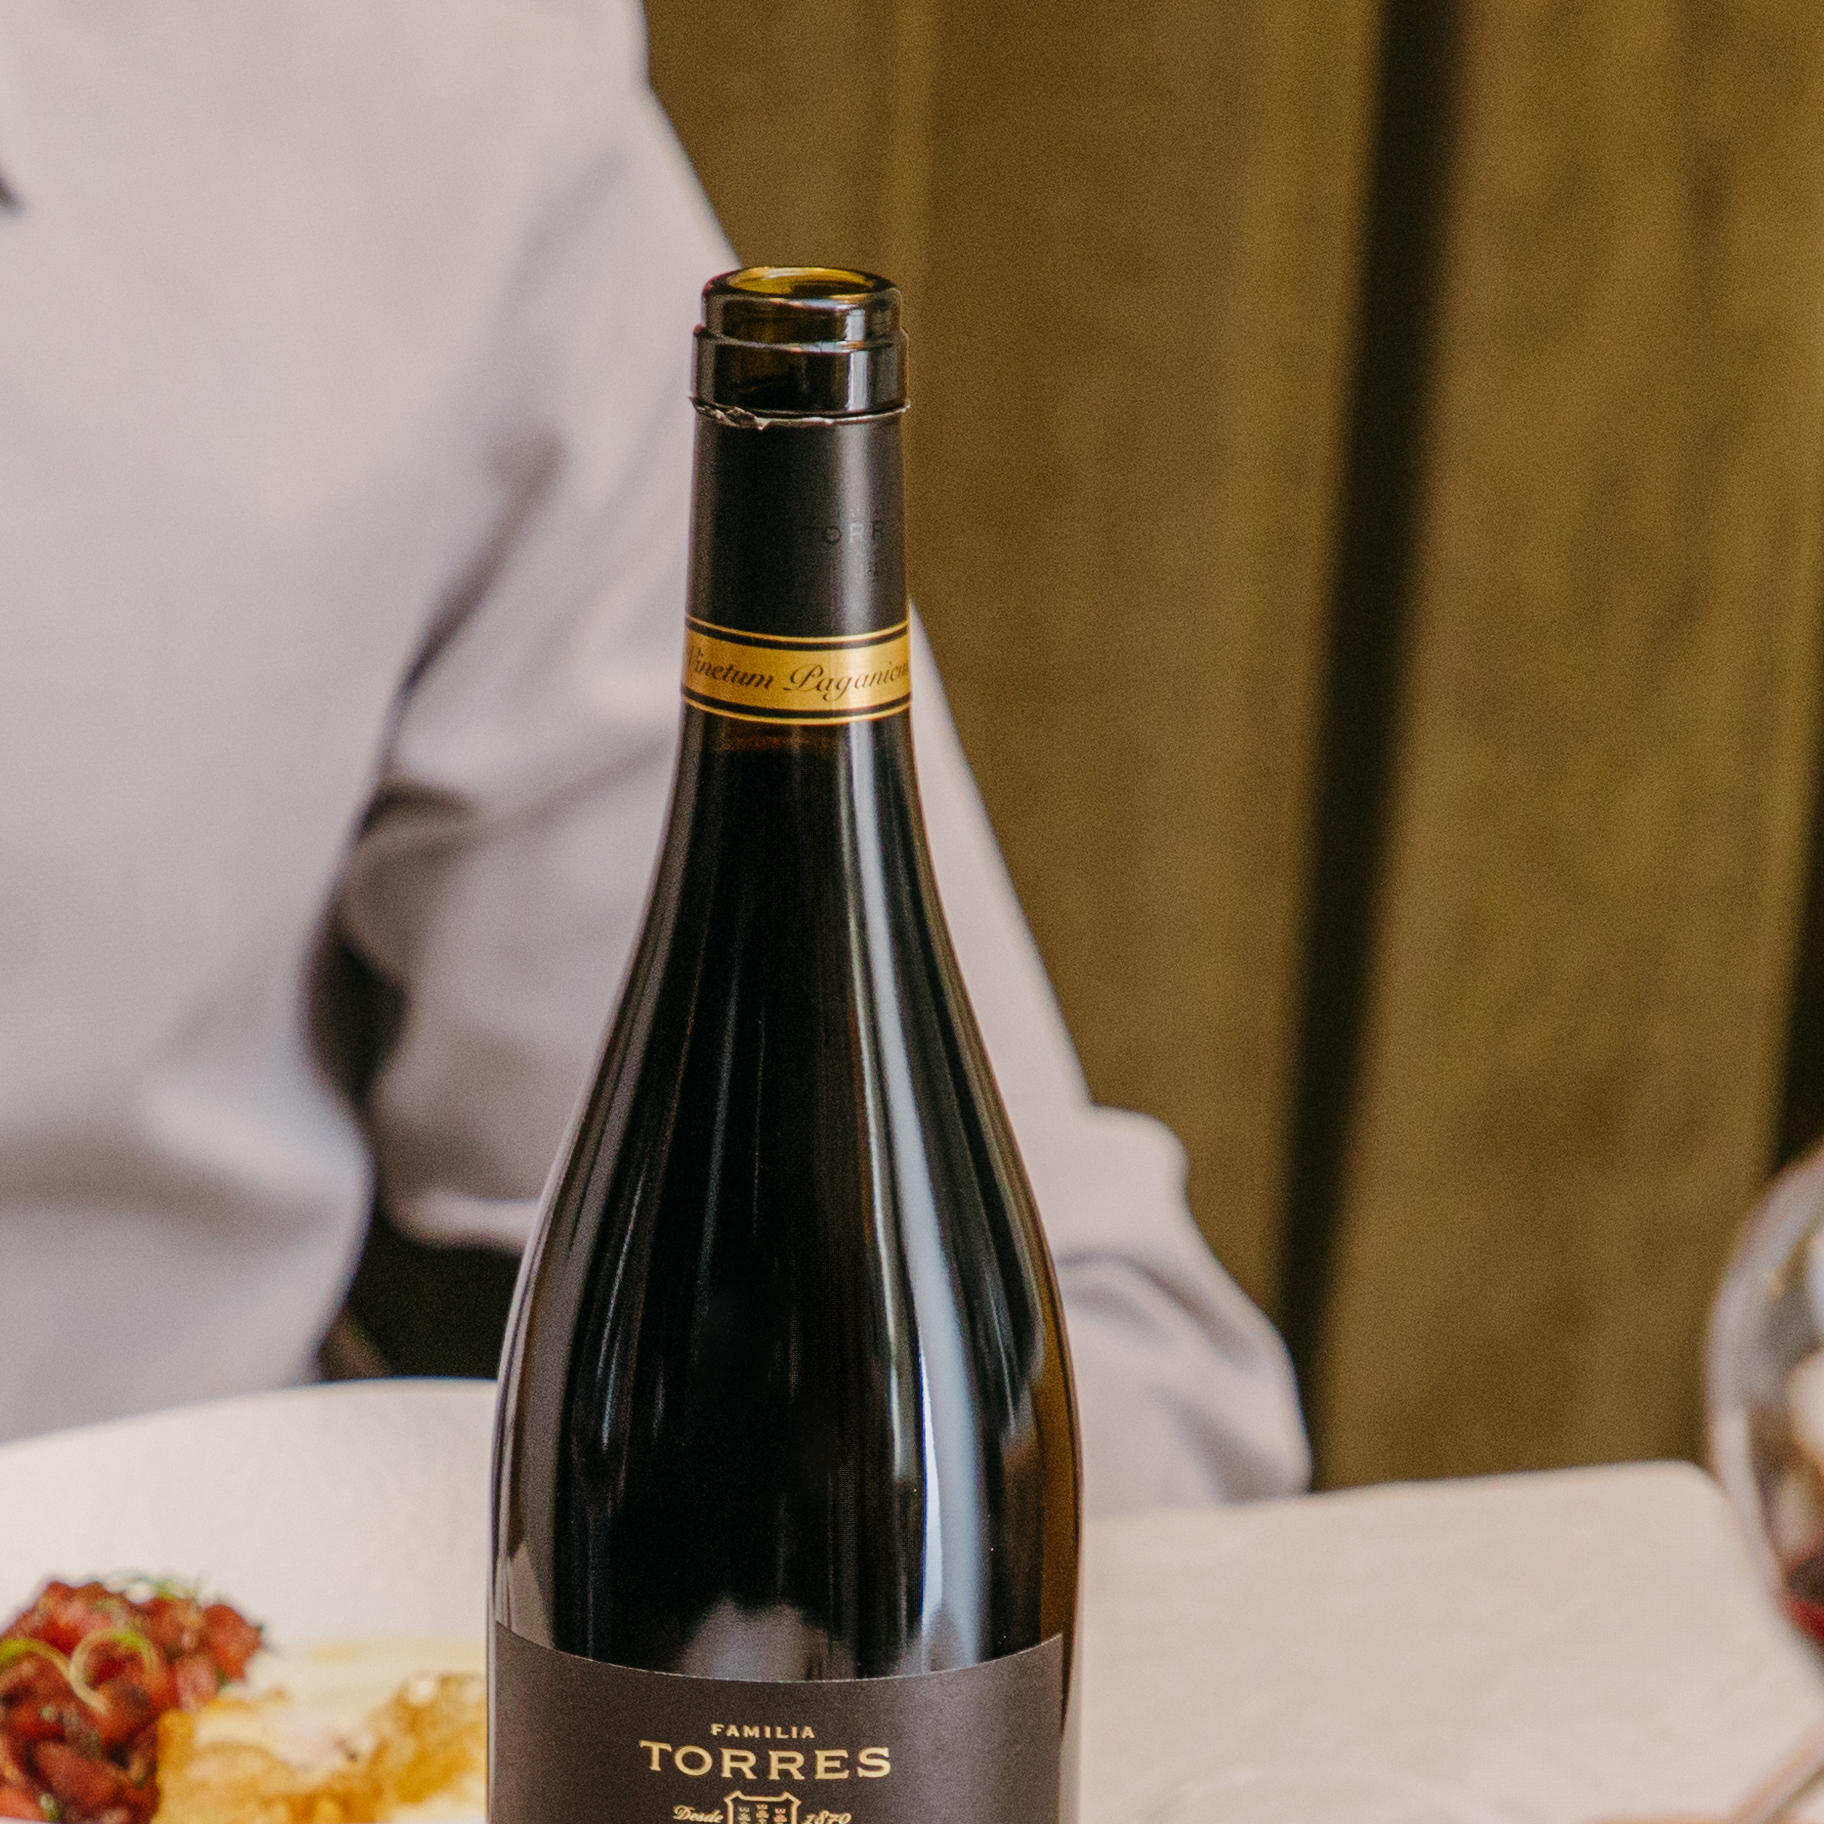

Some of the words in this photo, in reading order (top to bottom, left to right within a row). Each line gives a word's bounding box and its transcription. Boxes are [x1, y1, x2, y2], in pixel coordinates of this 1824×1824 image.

[710, 1723, 816, 1739] FAMILIA
[640, 1740, 892, 1780] TORRES
[672, 1804, 724, 1824] Desde
